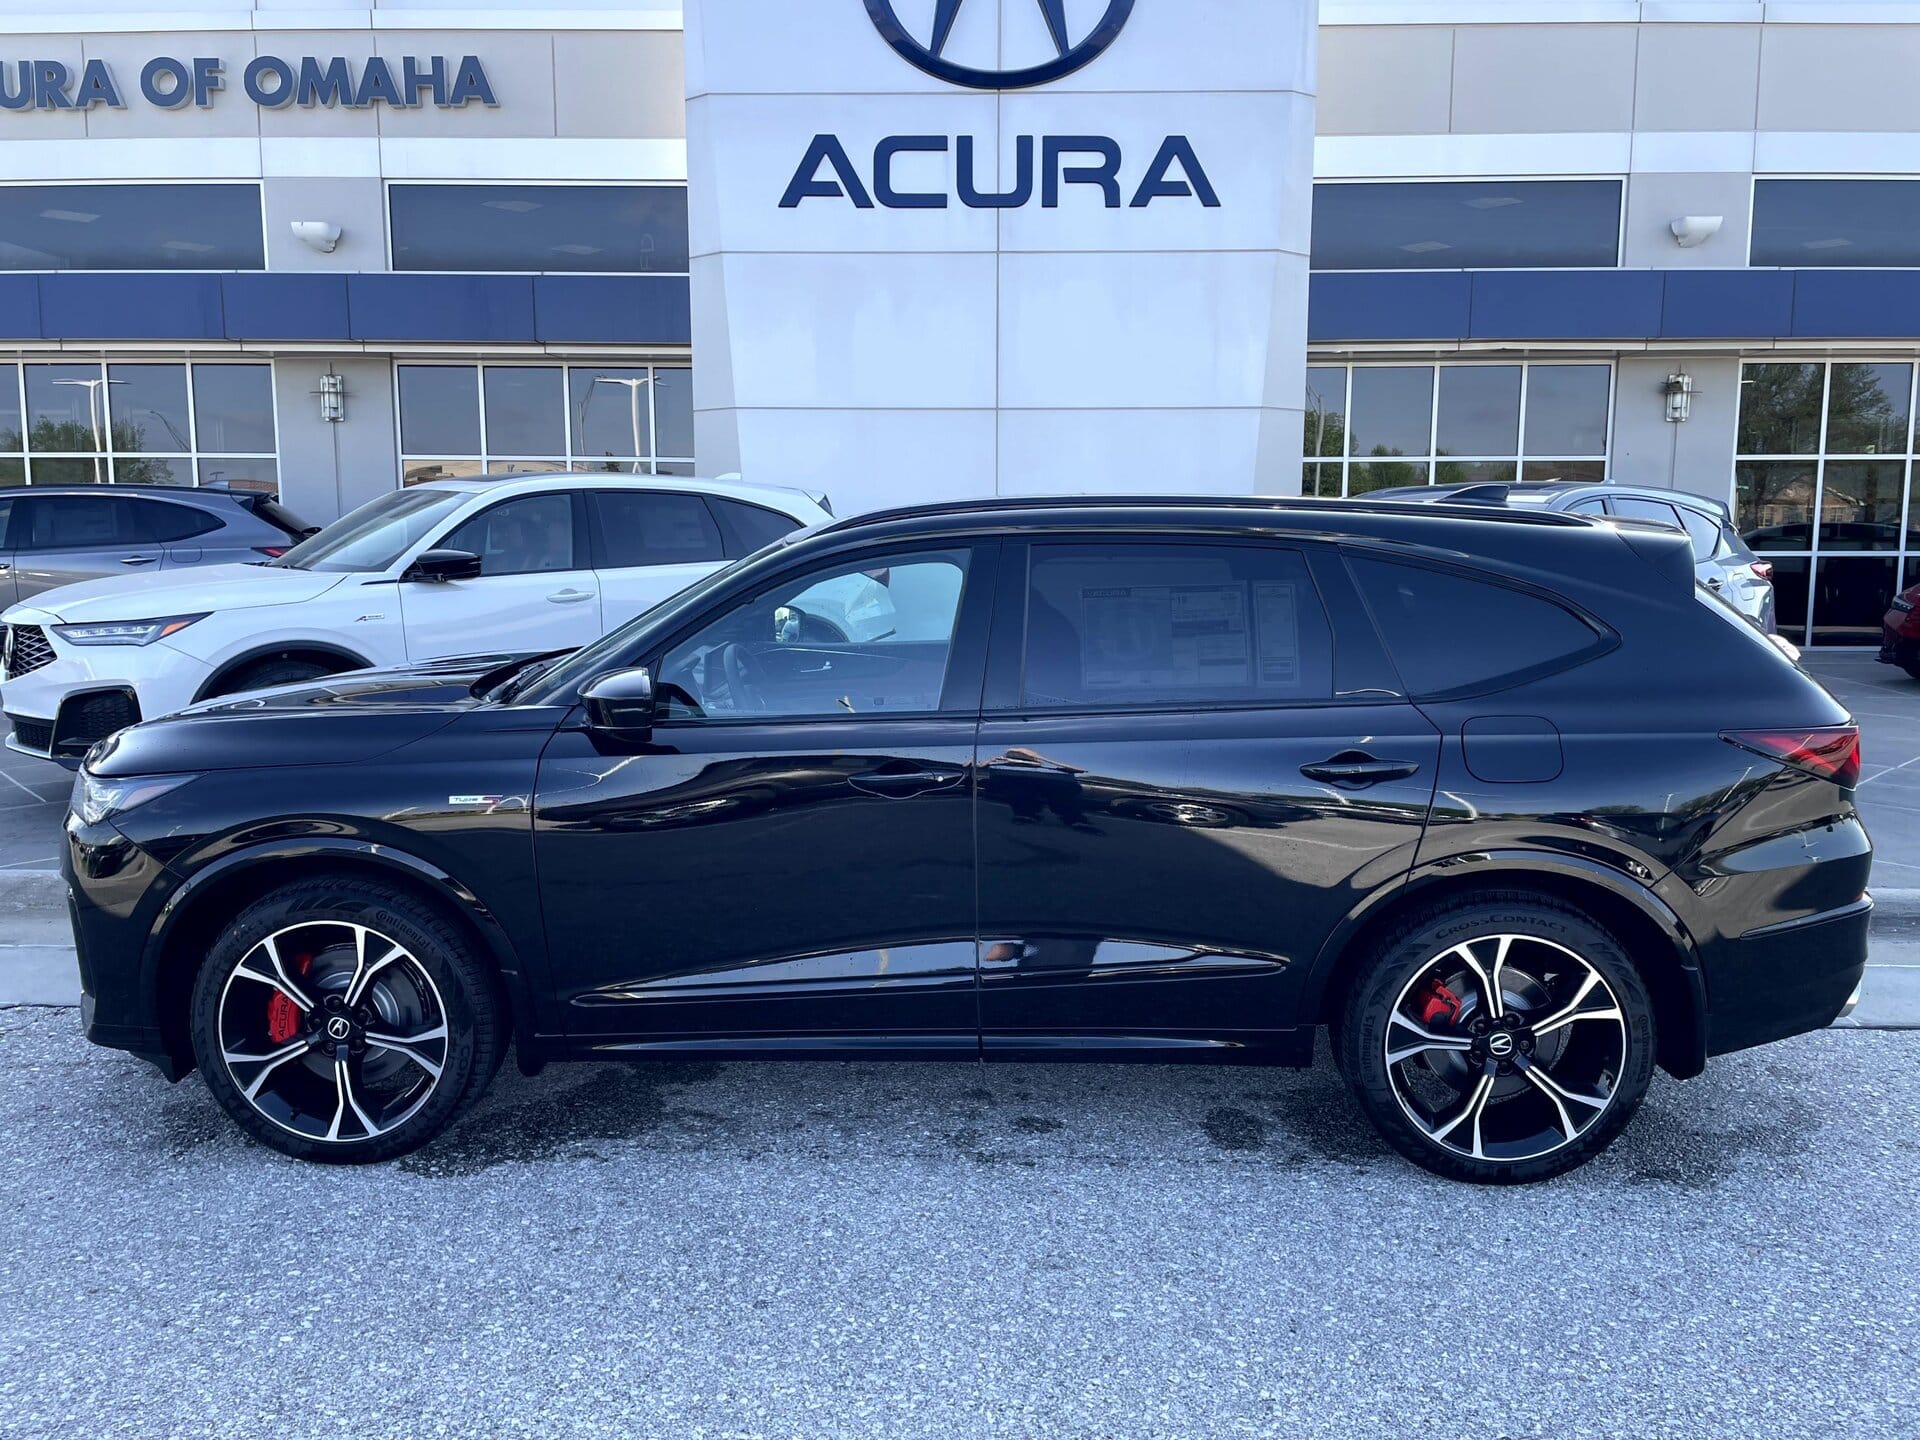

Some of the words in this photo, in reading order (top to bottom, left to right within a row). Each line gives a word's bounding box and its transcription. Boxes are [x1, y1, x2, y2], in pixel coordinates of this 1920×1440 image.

[0, 58, 124, 110] URA
[140, 56, 223, 109] OF
[244, 55, 499, 108] OMAHA
[778, 134, 1221, 208] ACURA
[278, 996, 289, 1038] ACURA
